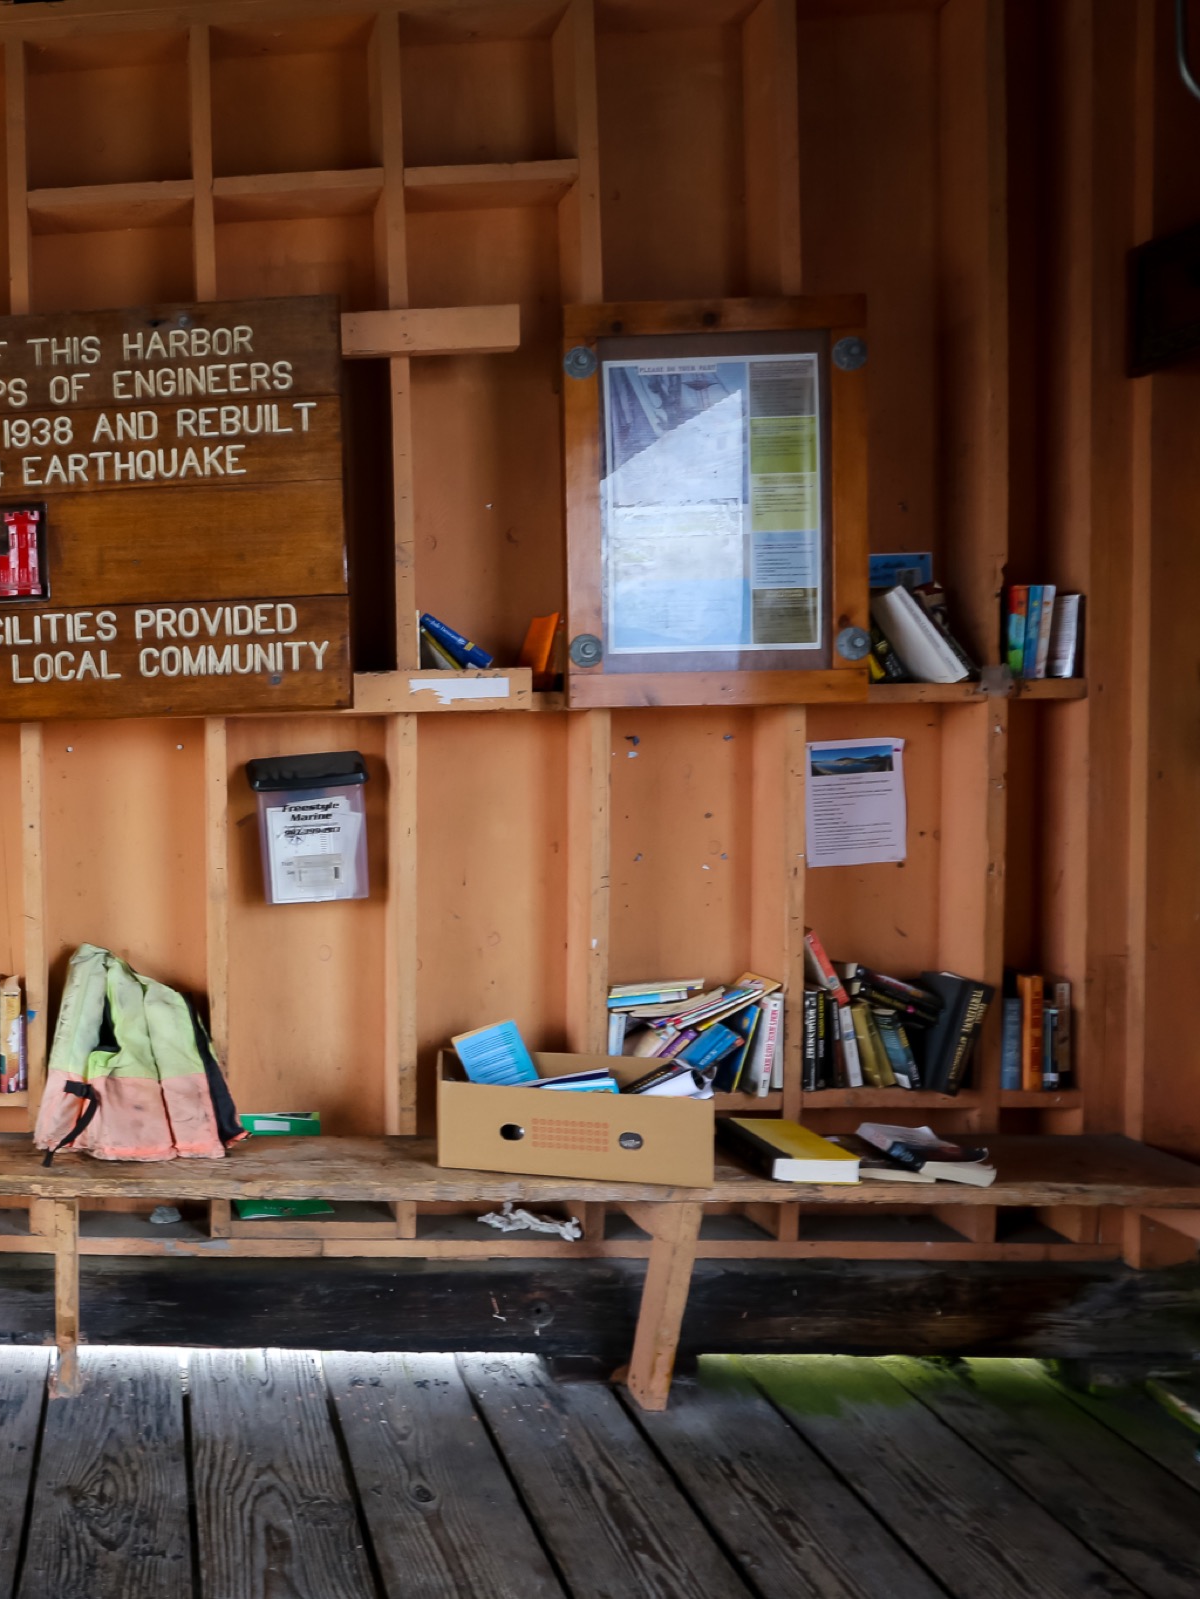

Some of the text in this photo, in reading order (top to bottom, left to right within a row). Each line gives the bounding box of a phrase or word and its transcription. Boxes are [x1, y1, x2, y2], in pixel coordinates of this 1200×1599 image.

[27, 337, 101, 367] THIS
[123, 325, 254, 360] HARBOR
[49, 373, 92, 404] OF
[113, 361, 294, 400] ENGINEERS
[3, 416, 74, 450] 1938
[93, 410, 159, 442] AND
[176, 401, 317, 438] REBUILT
[22, 443, 248, 486] EARTHQUAKE
[134, 602, 298, 639] PROVIDED
[12, 650, 122, 685] LOCAL
[139, 639, 330, 677] COMMUNITY
[282, 802, 340, 812] Freestyle
[290, 812, 333, 822] Marine
